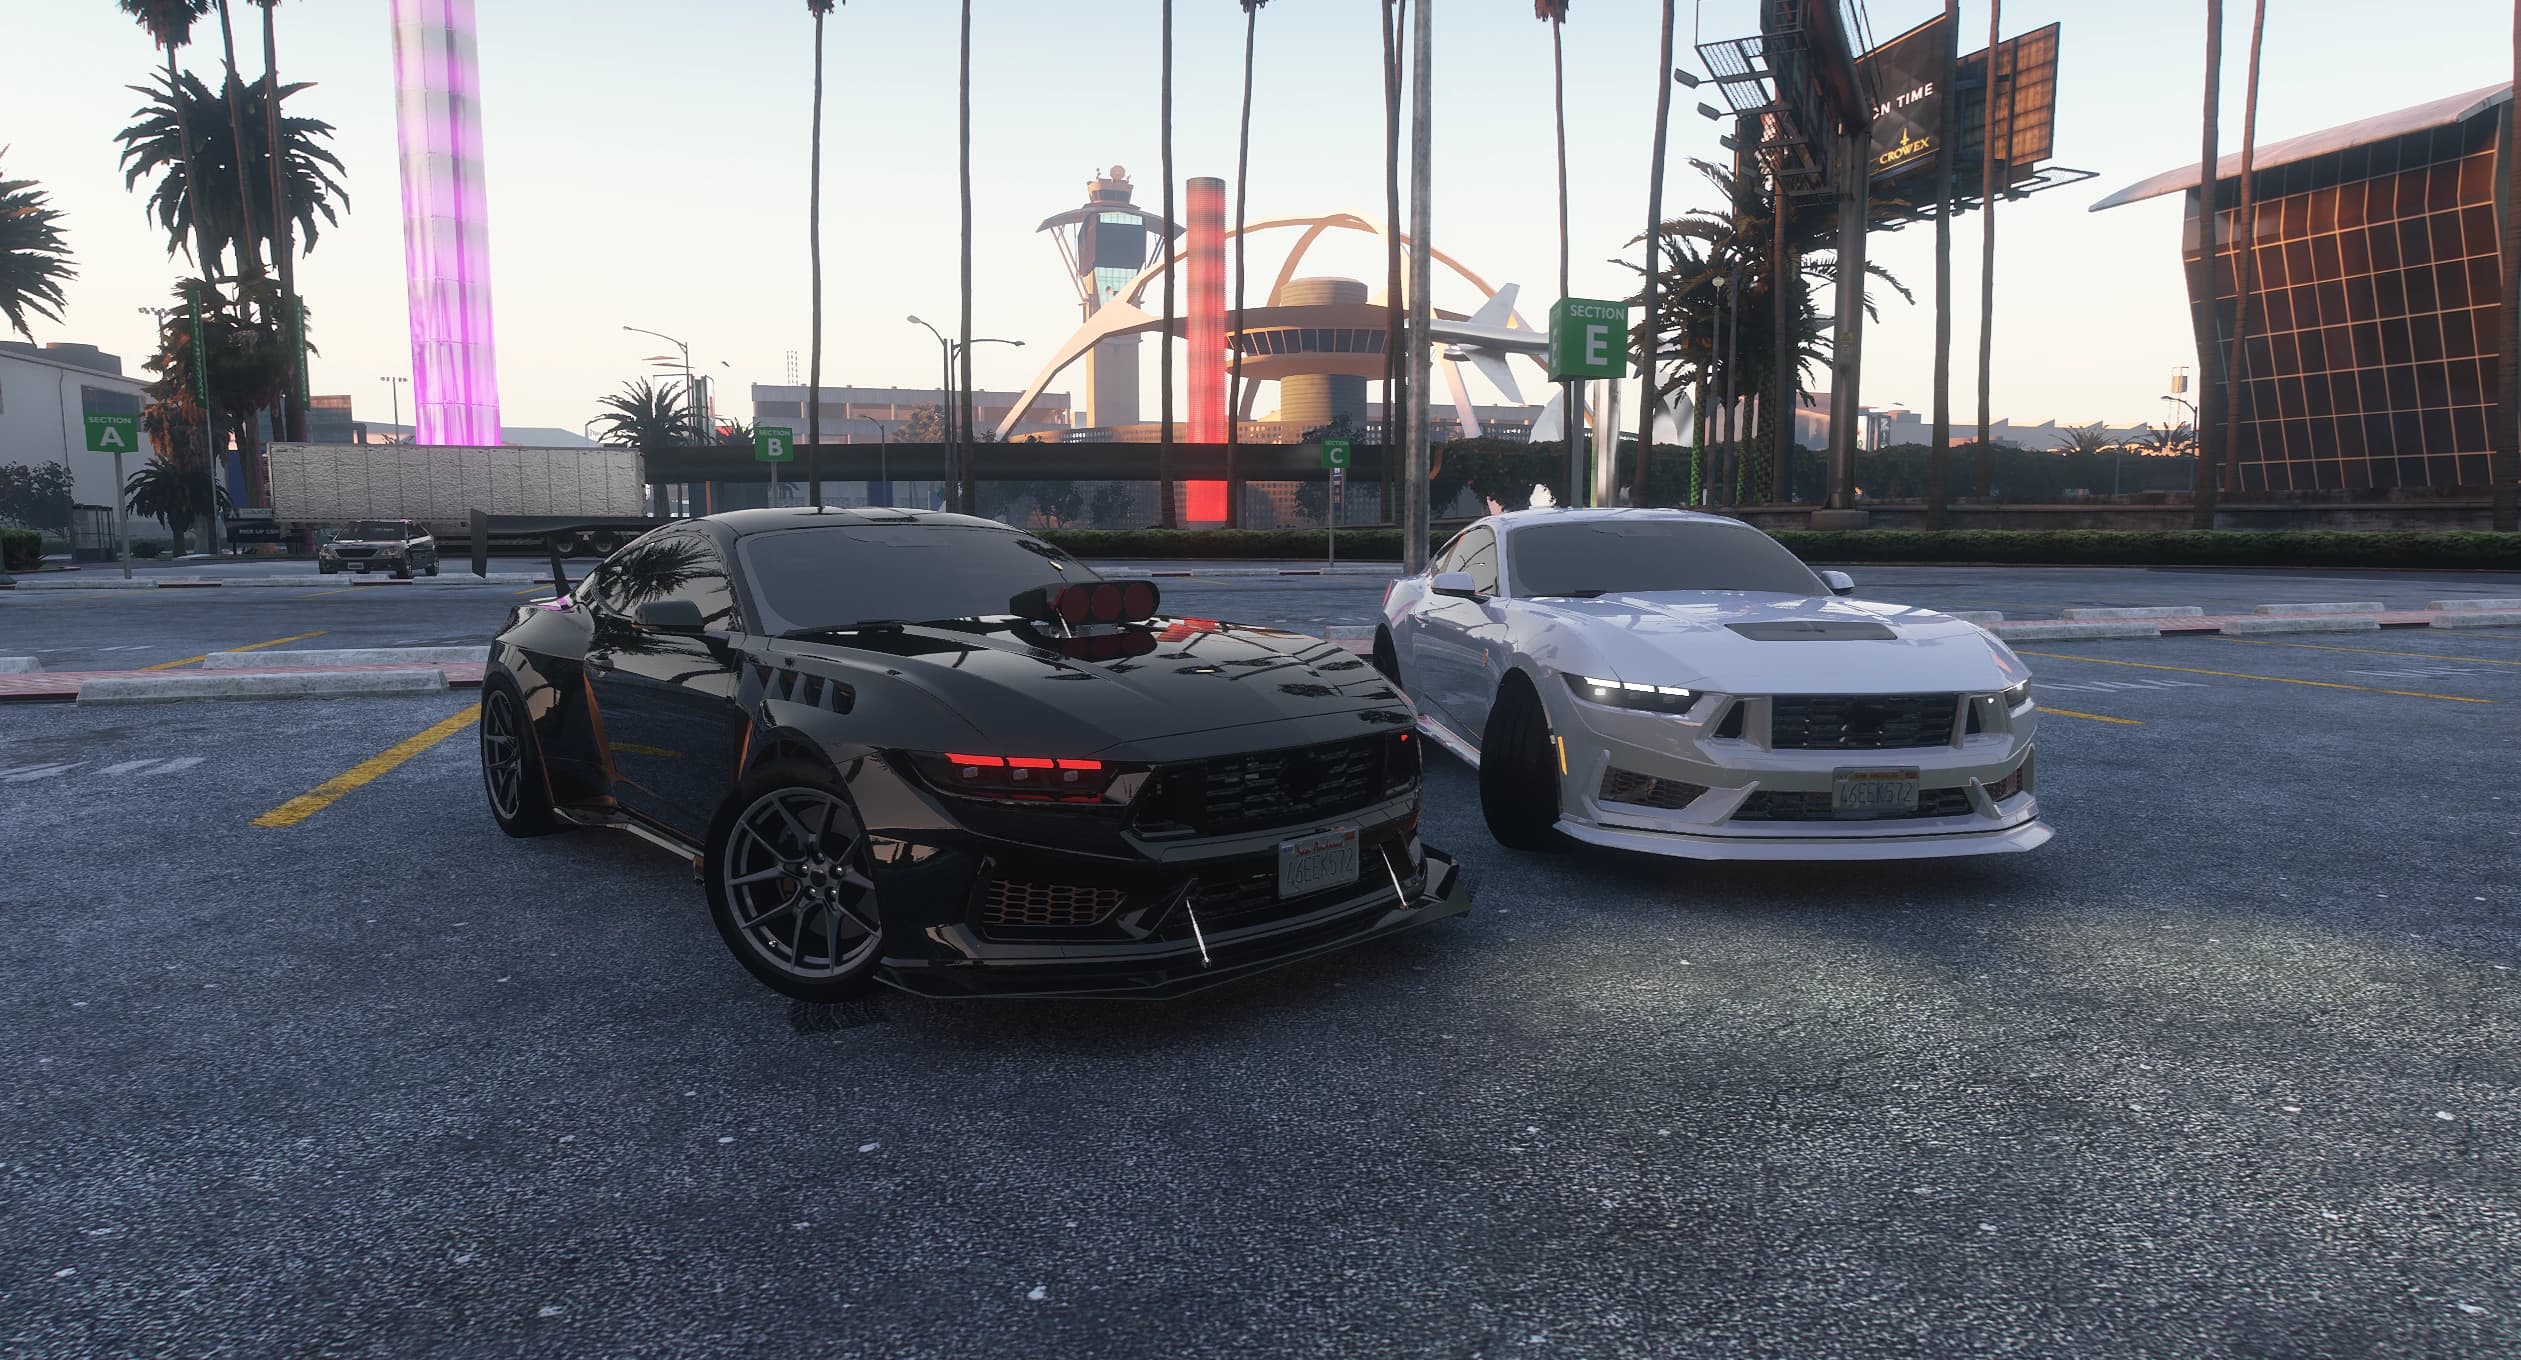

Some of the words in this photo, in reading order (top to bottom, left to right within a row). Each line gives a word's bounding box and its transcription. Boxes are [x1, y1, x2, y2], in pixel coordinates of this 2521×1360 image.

[1896, 82, 1934, 108] TIME
[1879, 137, 1930, 164] CROWEX
[1569, 304, 1625, 320] SECTION
[1586, 324, 1608, 365] E
[88, 416, 132, 424] SECTION
[99, 426, 125, 447] A
[767, 438, 783, 456] B
[1330, 447, 1343, 463] C
